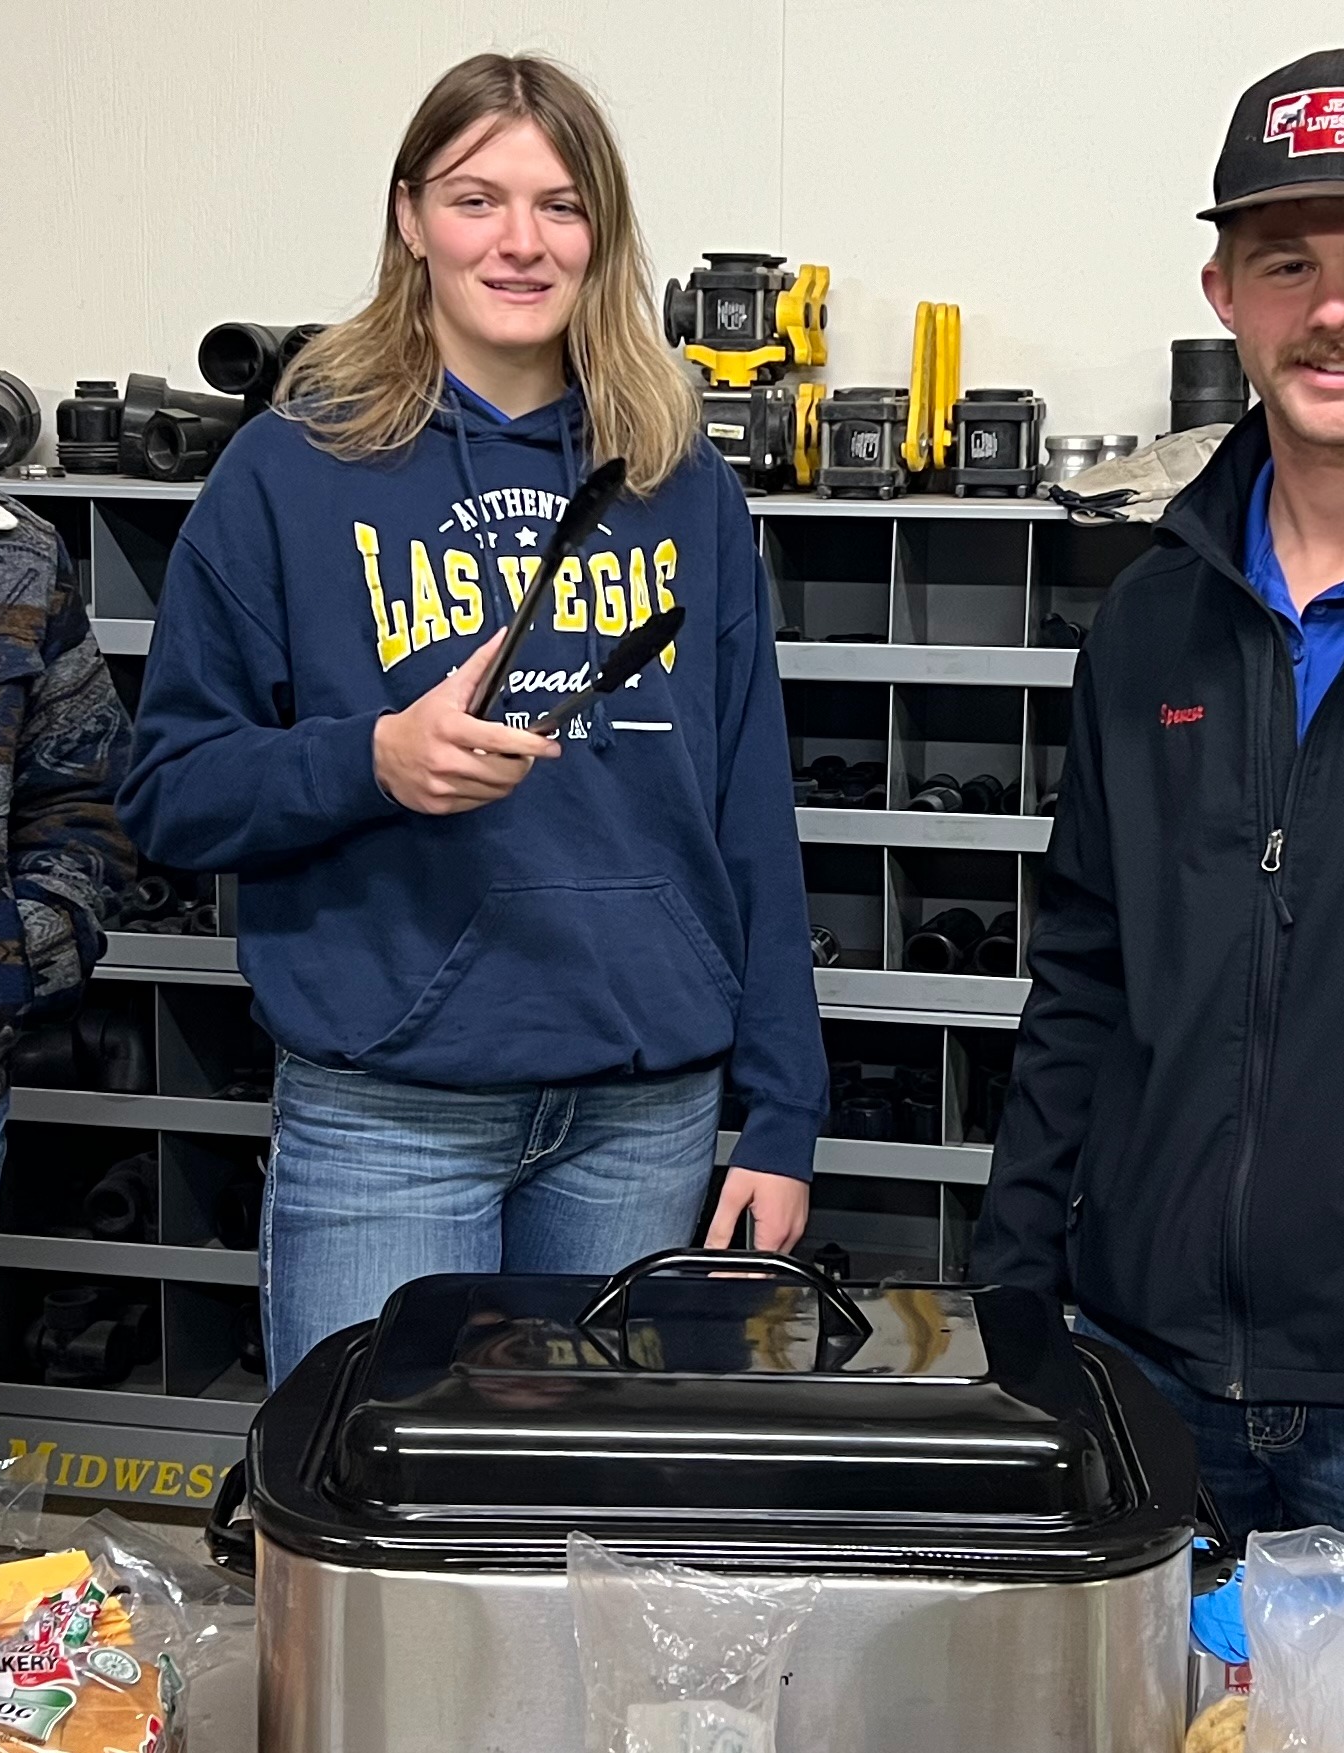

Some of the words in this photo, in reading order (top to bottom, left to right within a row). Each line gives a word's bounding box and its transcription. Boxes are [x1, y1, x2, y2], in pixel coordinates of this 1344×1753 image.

[451, 488, 570, 532] AUTHENT
[354, 521, 484, 672] LAS
[497, 538, 677, 673] VEGAS
